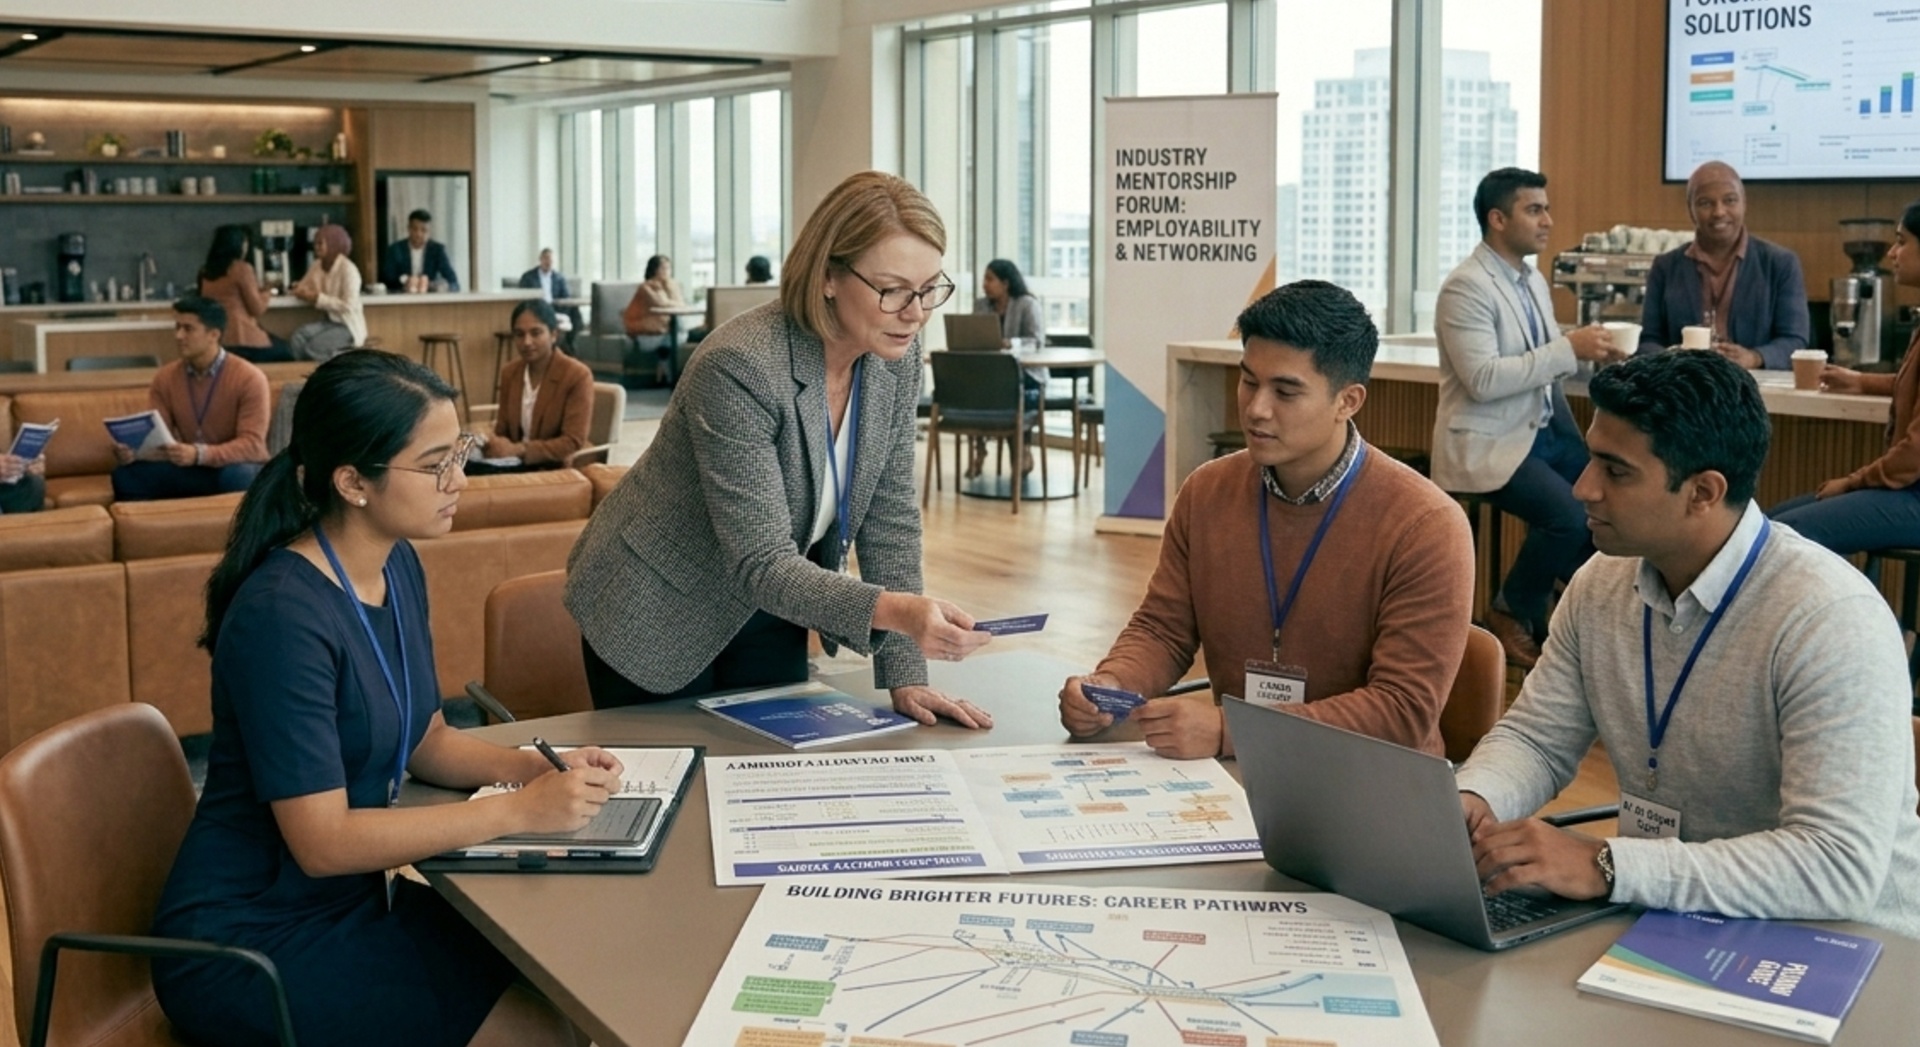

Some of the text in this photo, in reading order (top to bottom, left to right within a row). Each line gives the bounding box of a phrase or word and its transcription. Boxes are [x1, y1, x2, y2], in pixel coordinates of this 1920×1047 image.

[1684, 4, 1812, 36] SOLUTIONS
[1115, 148, 1208, 166] INDUSTRY
[1115, 171, 1237, 190] MENTORSHIP
[1115, 195, 1186, 214] FORUM:
[1115, 219, 1262, 238] EMPLOYABILITY
[1115, 242, 1257, 262] & NETWORKING
[786, 884, 1308, 914] BUILDING BRIGHTER FUTURES: CAREER PATHWAYS
